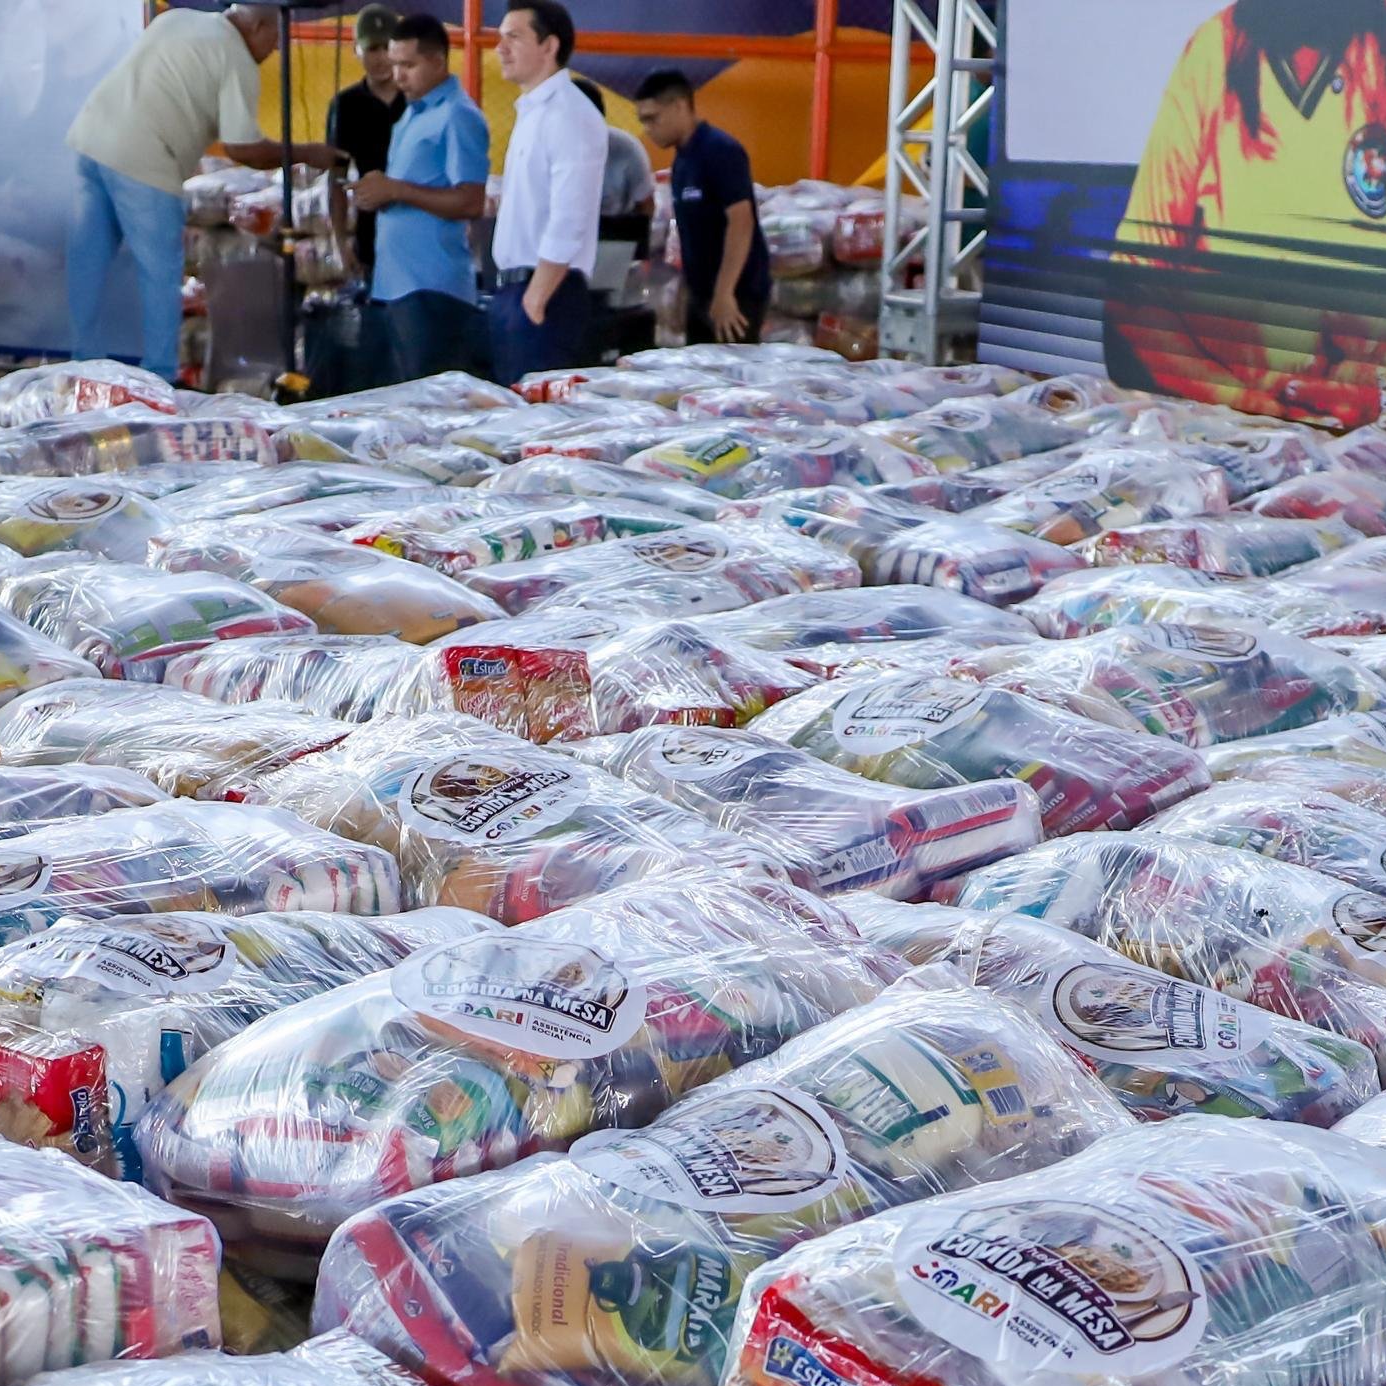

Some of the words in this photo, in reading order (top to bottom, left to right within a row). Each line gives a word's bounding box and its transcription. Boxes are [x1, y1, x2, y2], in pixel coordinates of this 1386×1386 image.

[485, 804, 543, 840] COARI
[433, 982, 517, 1001] COMIDA
[521, 988, 547, 1003] NA
[550, 997, 609, 1029] MESA
[531, 1025, 566, 1042] SOCIAL
[532, 1019, 593, 1046] ASSISTÊNCIA
[552, 1240, 570, 1327] Tradicional
[911, 1259, 1010, 1320] COARI
[943, 1232, 1030, 1280] COMIDA
[1029, 1272, 1063, 1298] NA
[1056, 1290, 1126, 1350] MESA
[1012, 1314, 1074, 1360] ASSISTÊNIA
